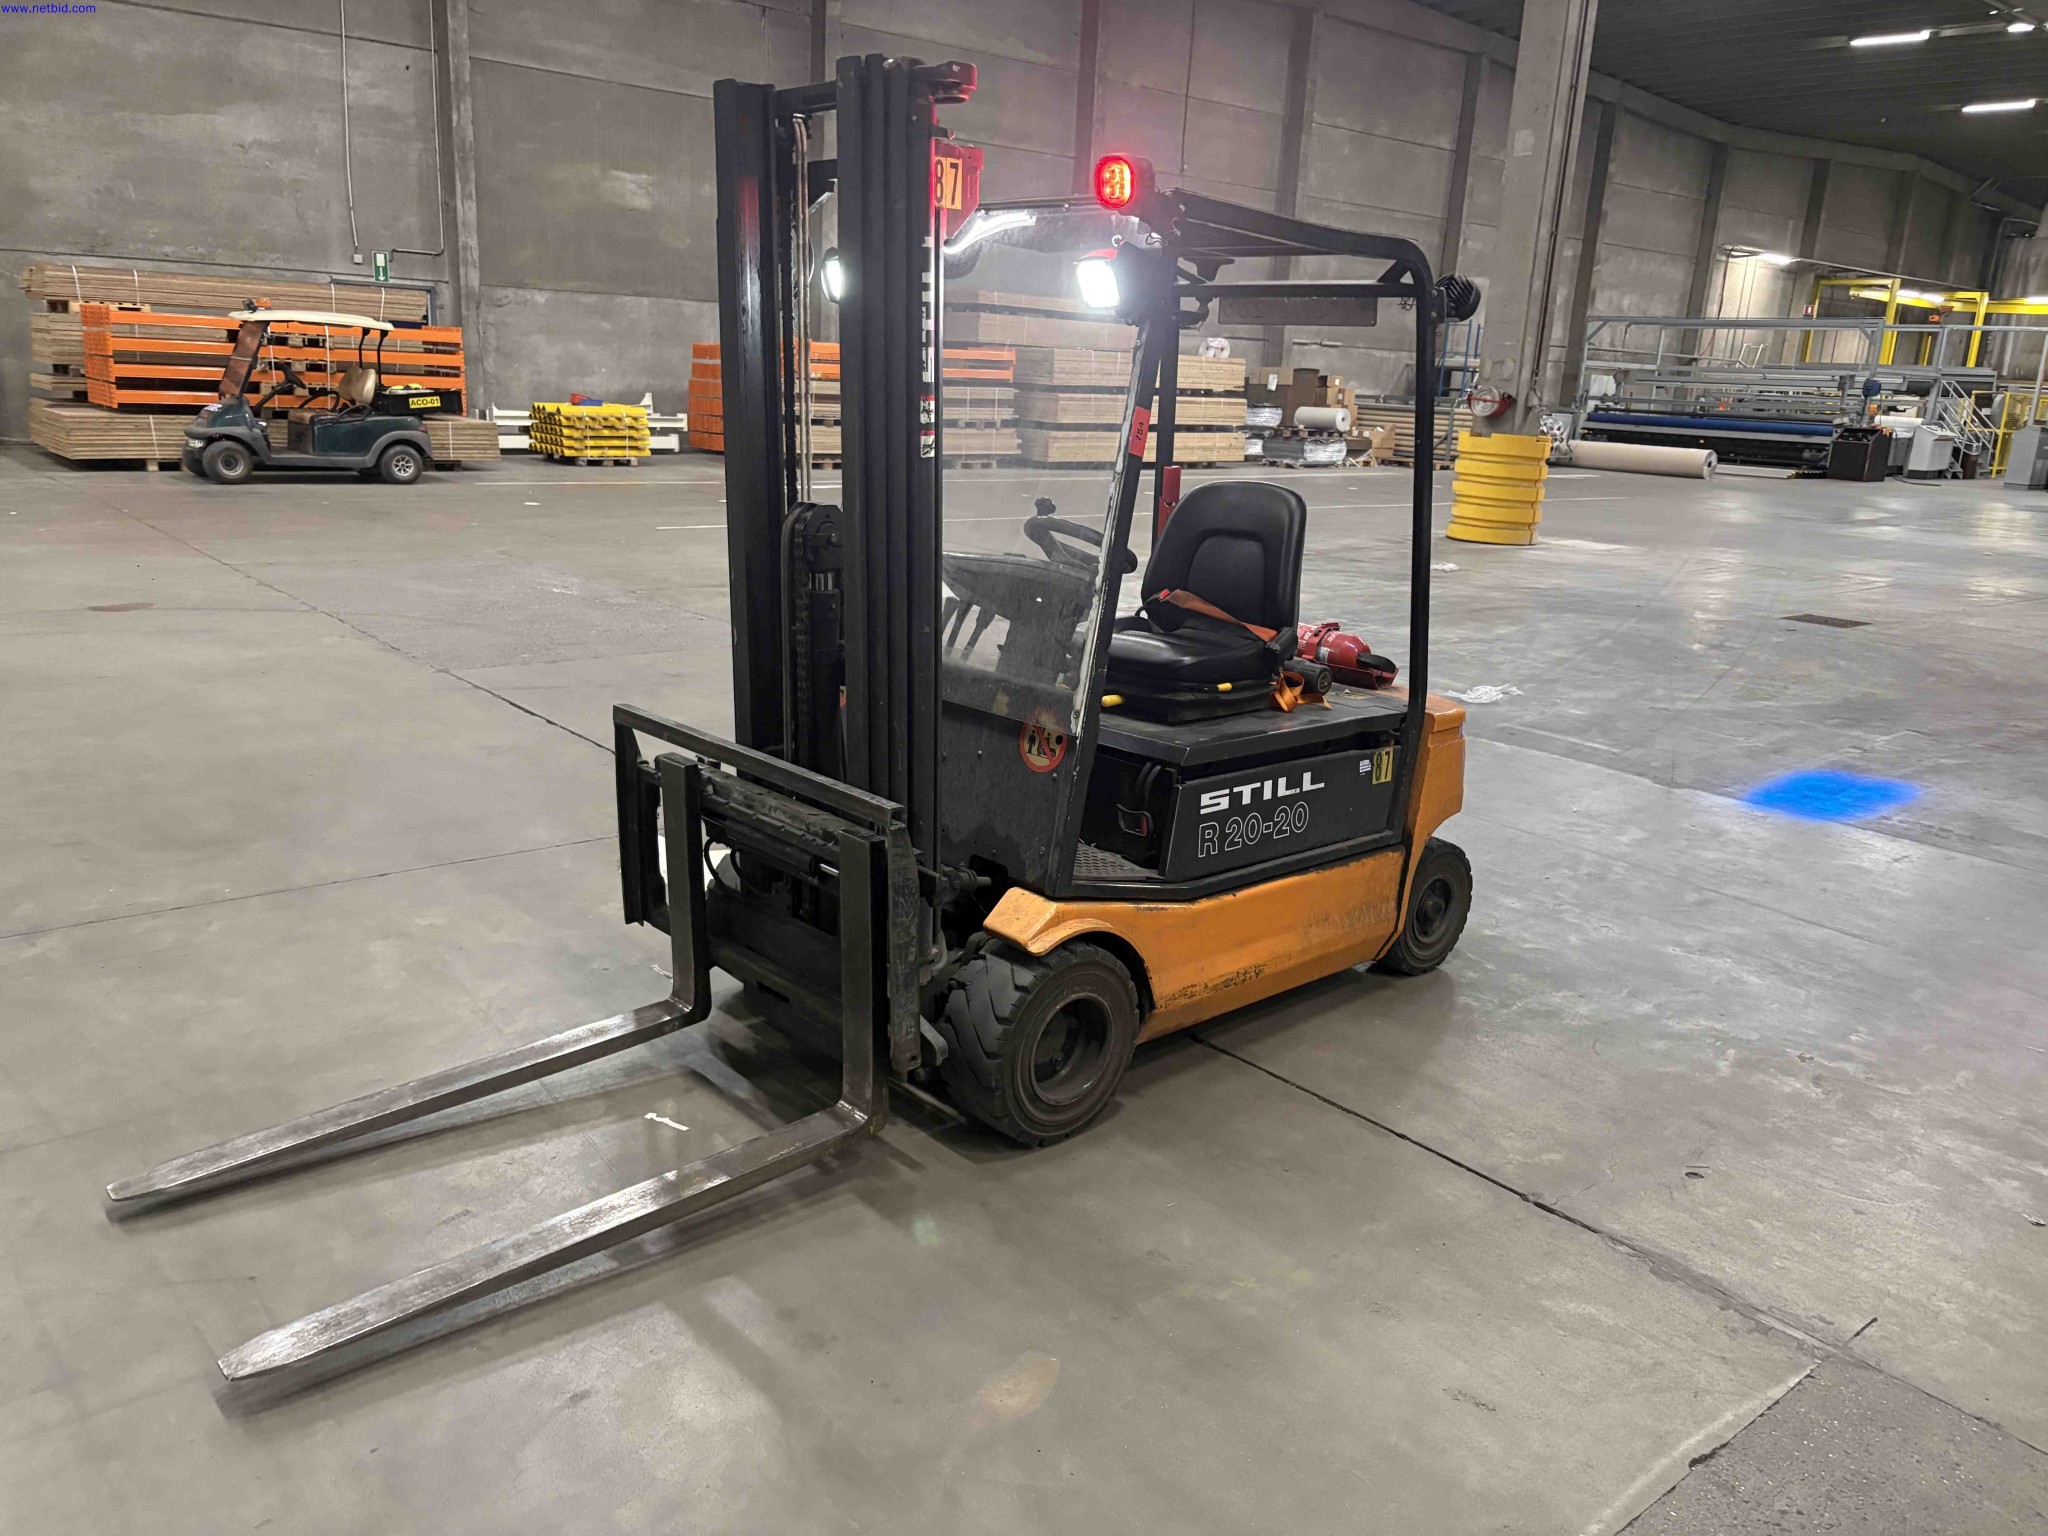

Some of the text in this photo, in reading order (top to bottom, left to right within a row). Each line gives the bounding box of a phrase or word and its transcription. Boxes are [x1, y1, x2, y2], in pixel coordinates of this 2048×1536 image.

[935, 158, 960, 206] 87
[1374, 750, 1391, 782] 87
[1200, 771, 1325, 815] STILL
[1198, 801, 1309, 857] R 20-20
